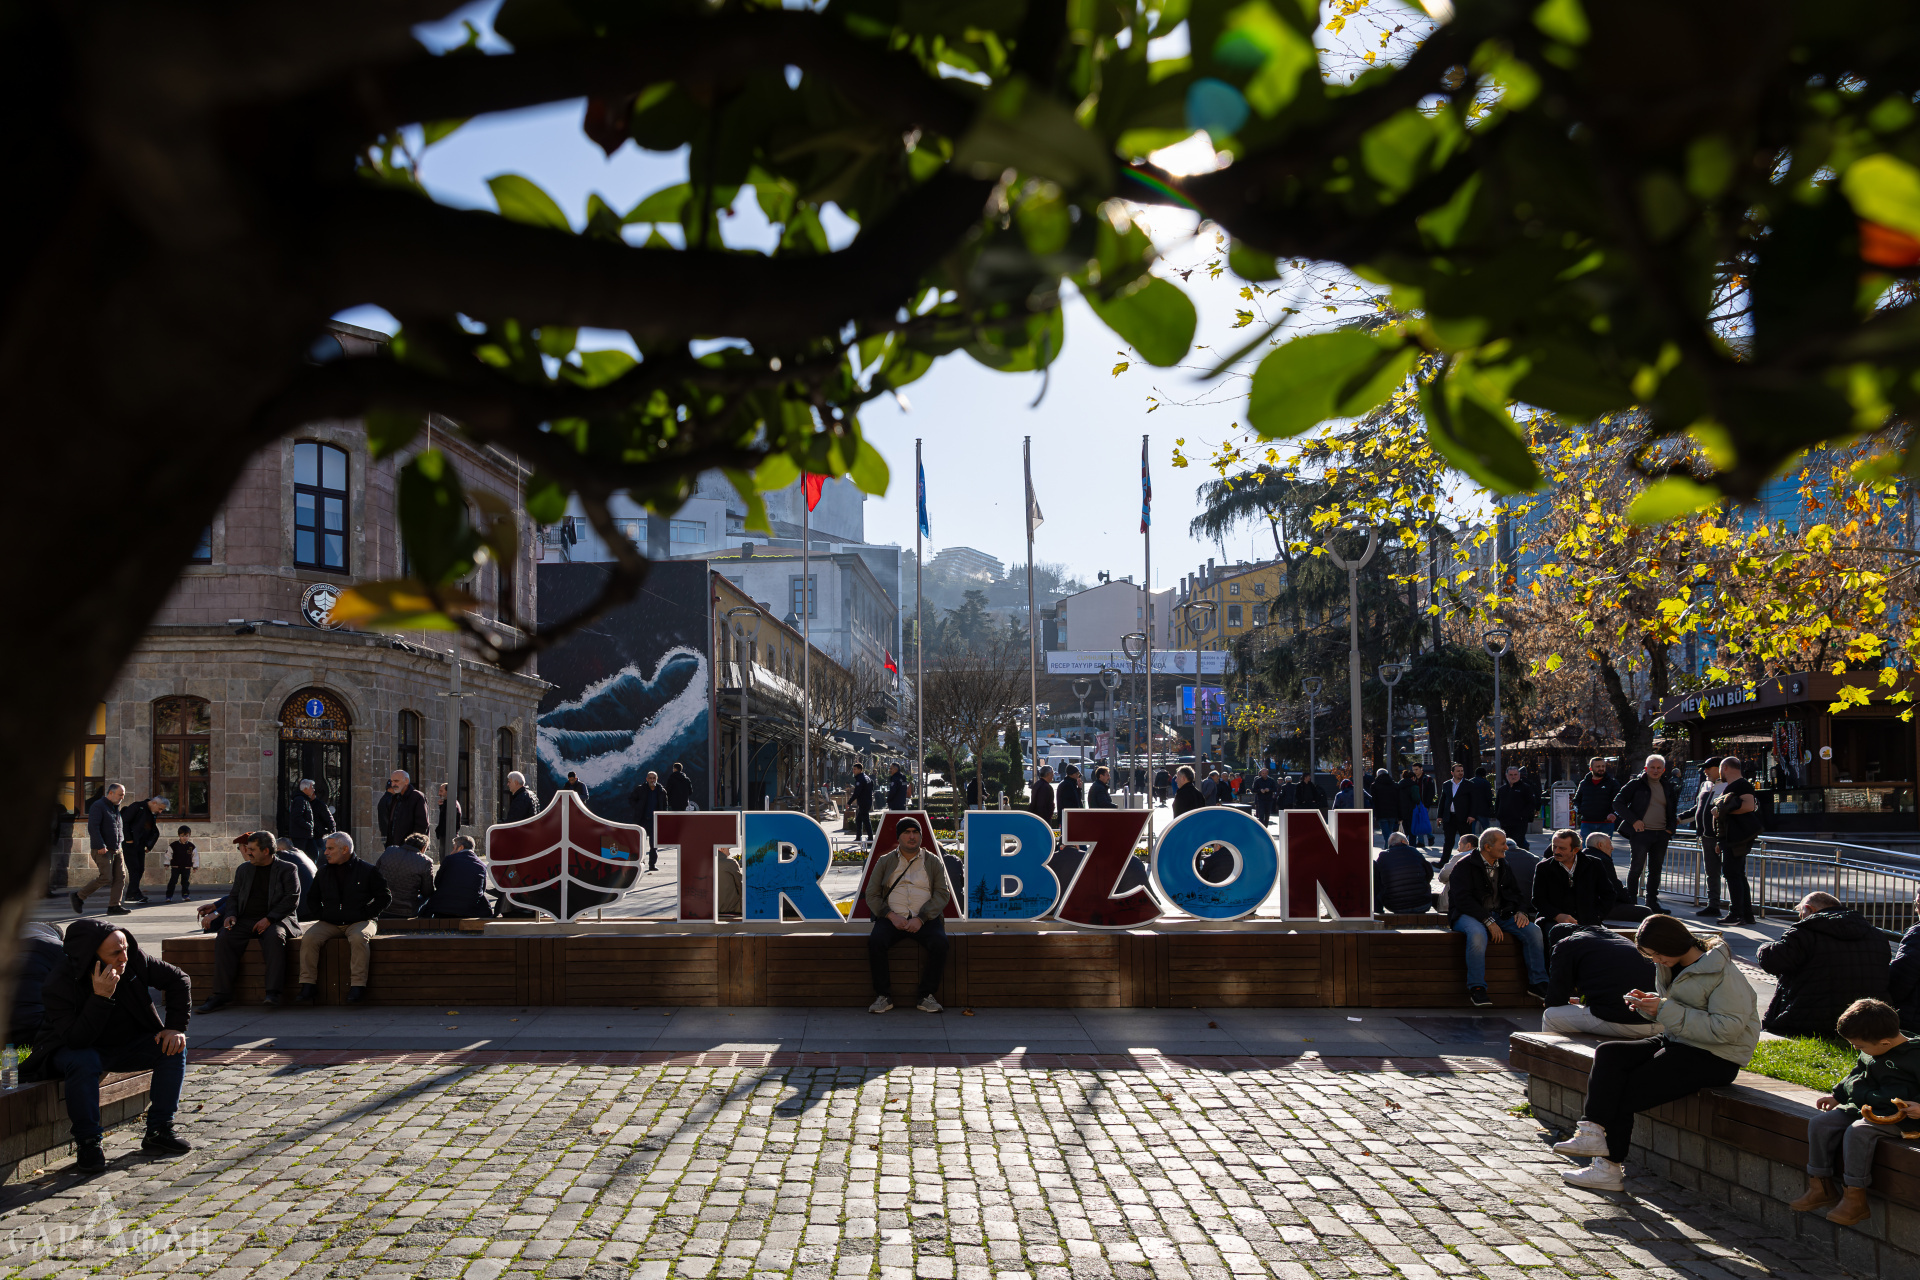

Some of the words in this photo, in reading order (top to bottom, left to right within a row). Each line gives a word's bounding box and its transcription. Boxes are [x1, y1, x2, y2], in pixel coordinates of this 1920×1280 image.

[1681, 693, 1724, 713] MEYAN
[294, 718, 336, 729] TOURIST
[282, 728, 348, 740] INFORMATION
